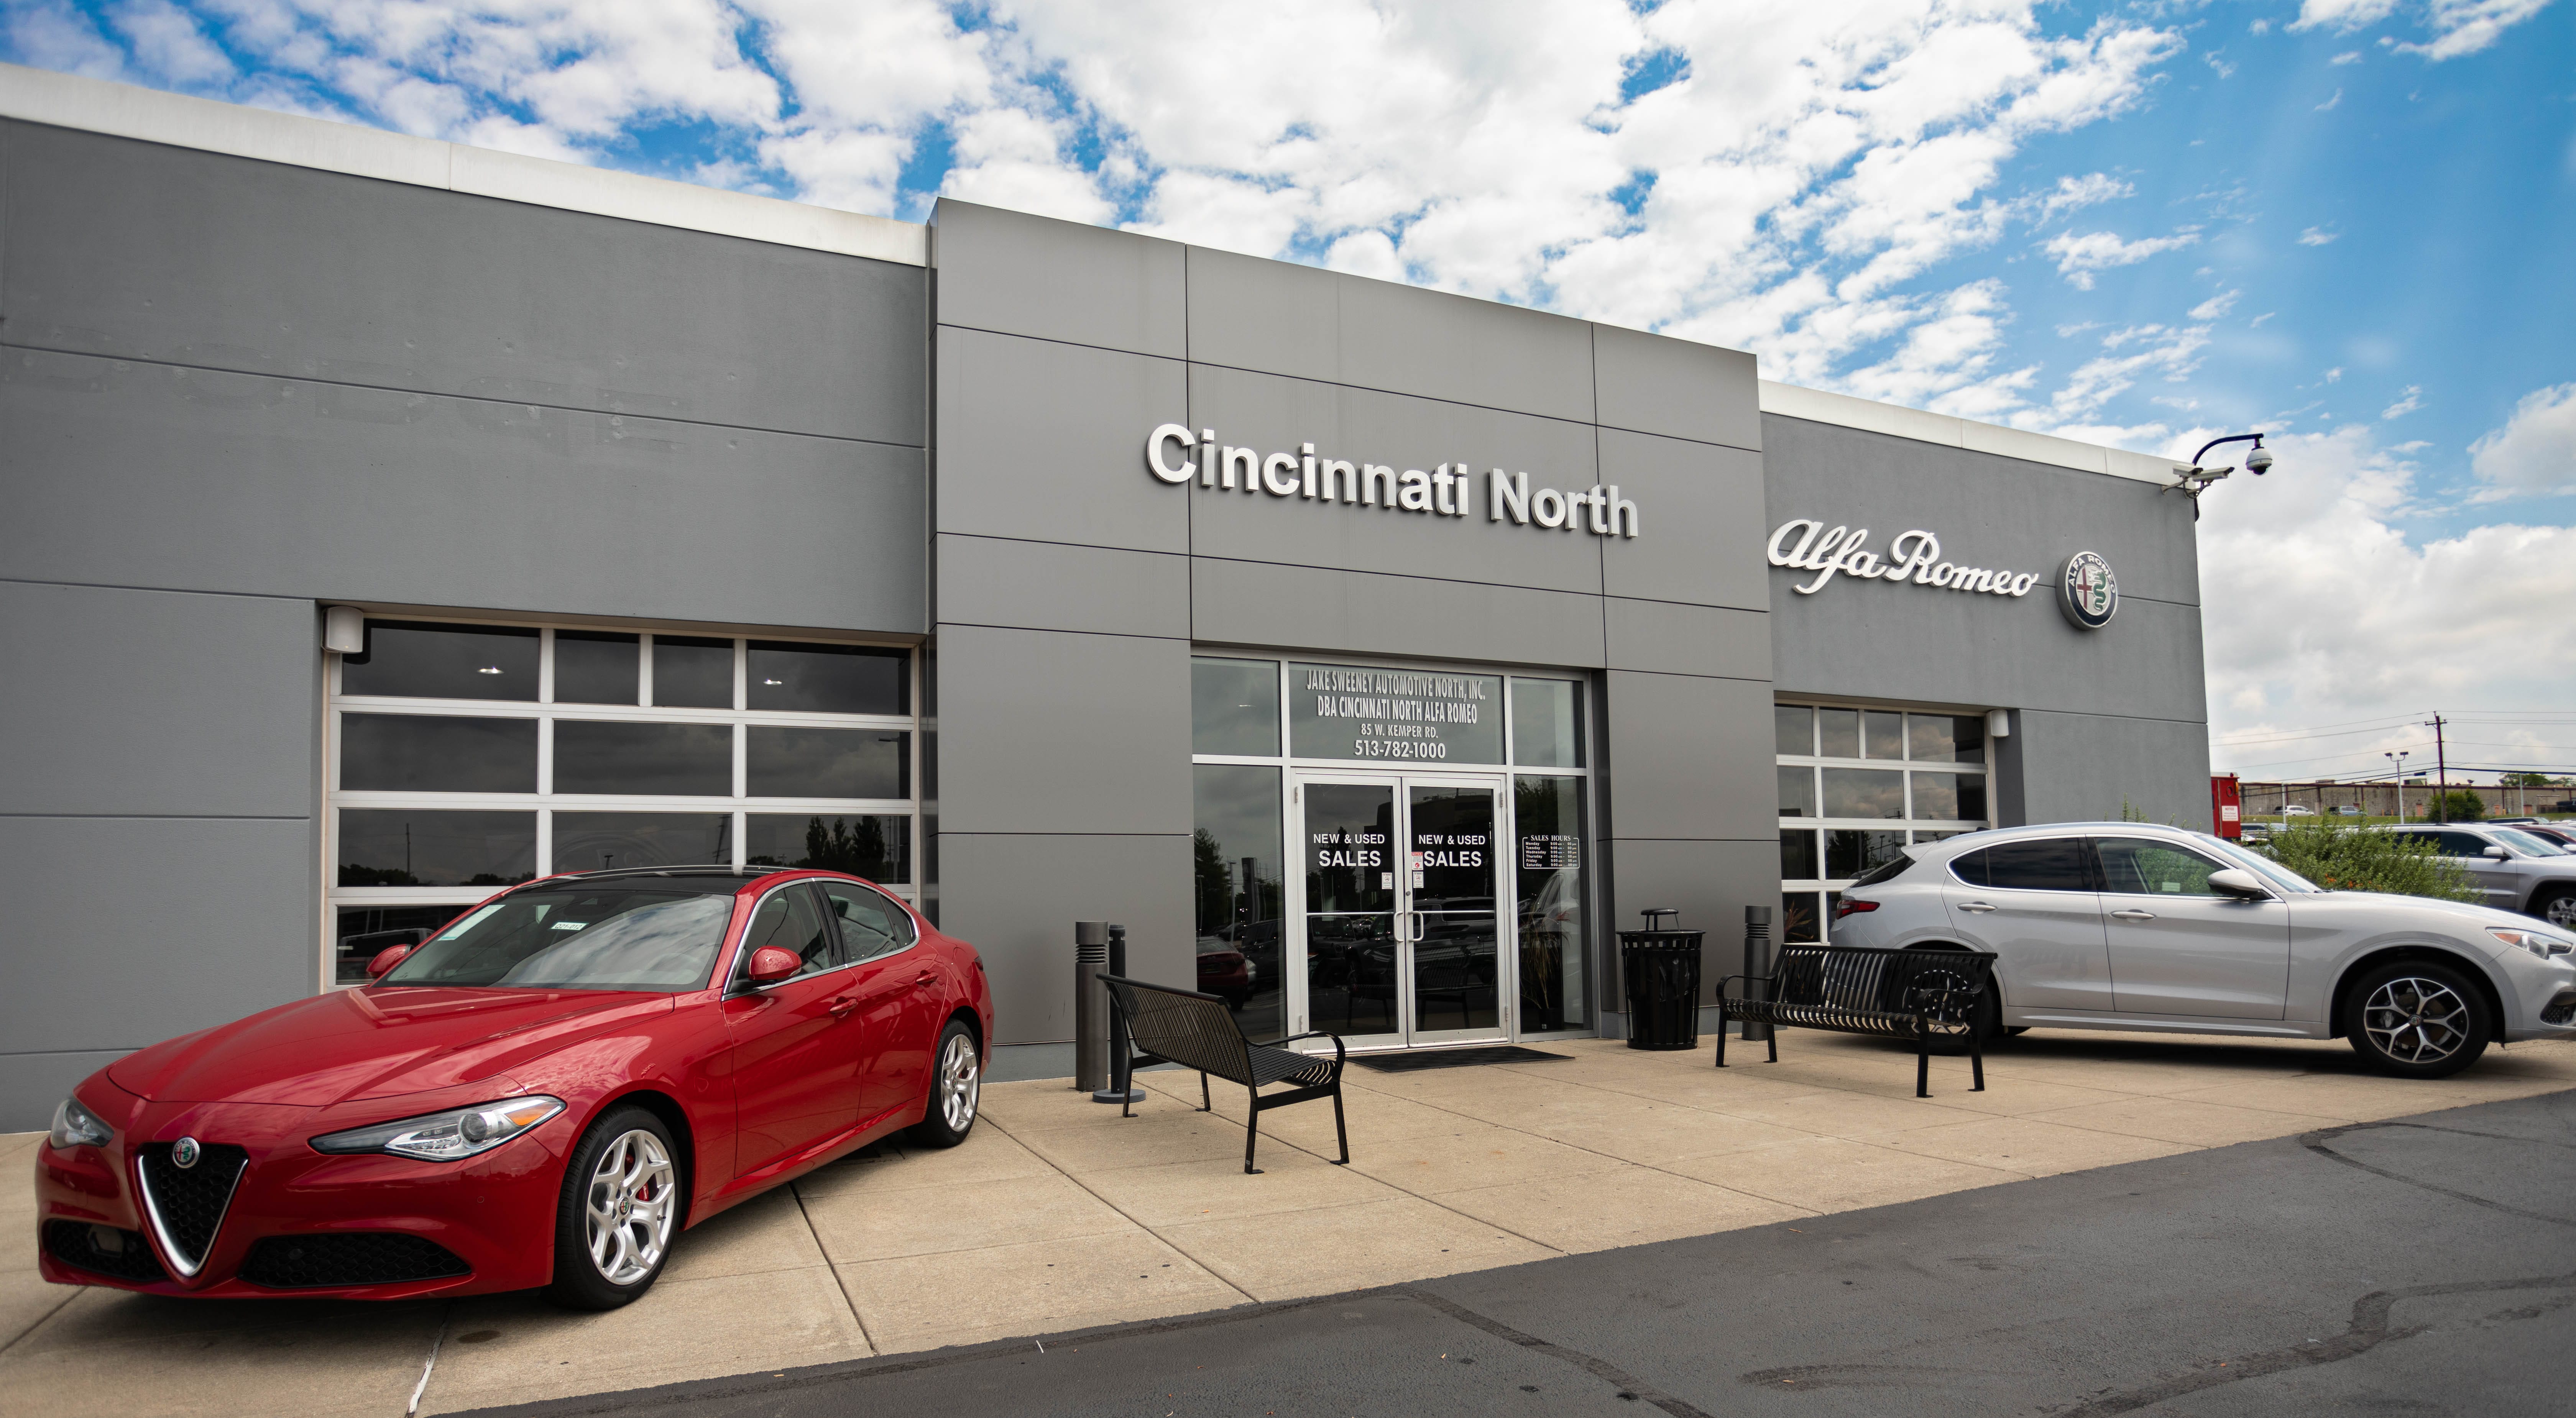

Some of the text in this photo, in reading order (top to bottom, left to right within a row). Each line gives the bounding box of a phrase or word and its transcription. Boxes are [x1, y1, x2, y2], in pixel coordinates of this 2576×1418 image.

[1148, 423, 1638, 537] Cincinnati North
[1768, 519, 2039, 597] Alfa Romeo
[2068, 555, 2115, 594] ALFA ROMEO
[1307, 670, 1485, 702] JAKE SWEENEY AUTOMOTIVE NORTH, INC.
[1318, 696, 1477, 724] DBA CINCINNATI NORTH ALFA ROMEO
[1361, 724, 1438, 738] 85 W. KEMPER RD.
[1355, 740, 1446, 758] 513-782-1000
[1313, 834, 1385, 844] NEW & USED
[1419, 835, 1485, 845] NEW & USED
[1319, 850, 1381, 867] SALES
[1424, 851, 1481, 867] SALES
